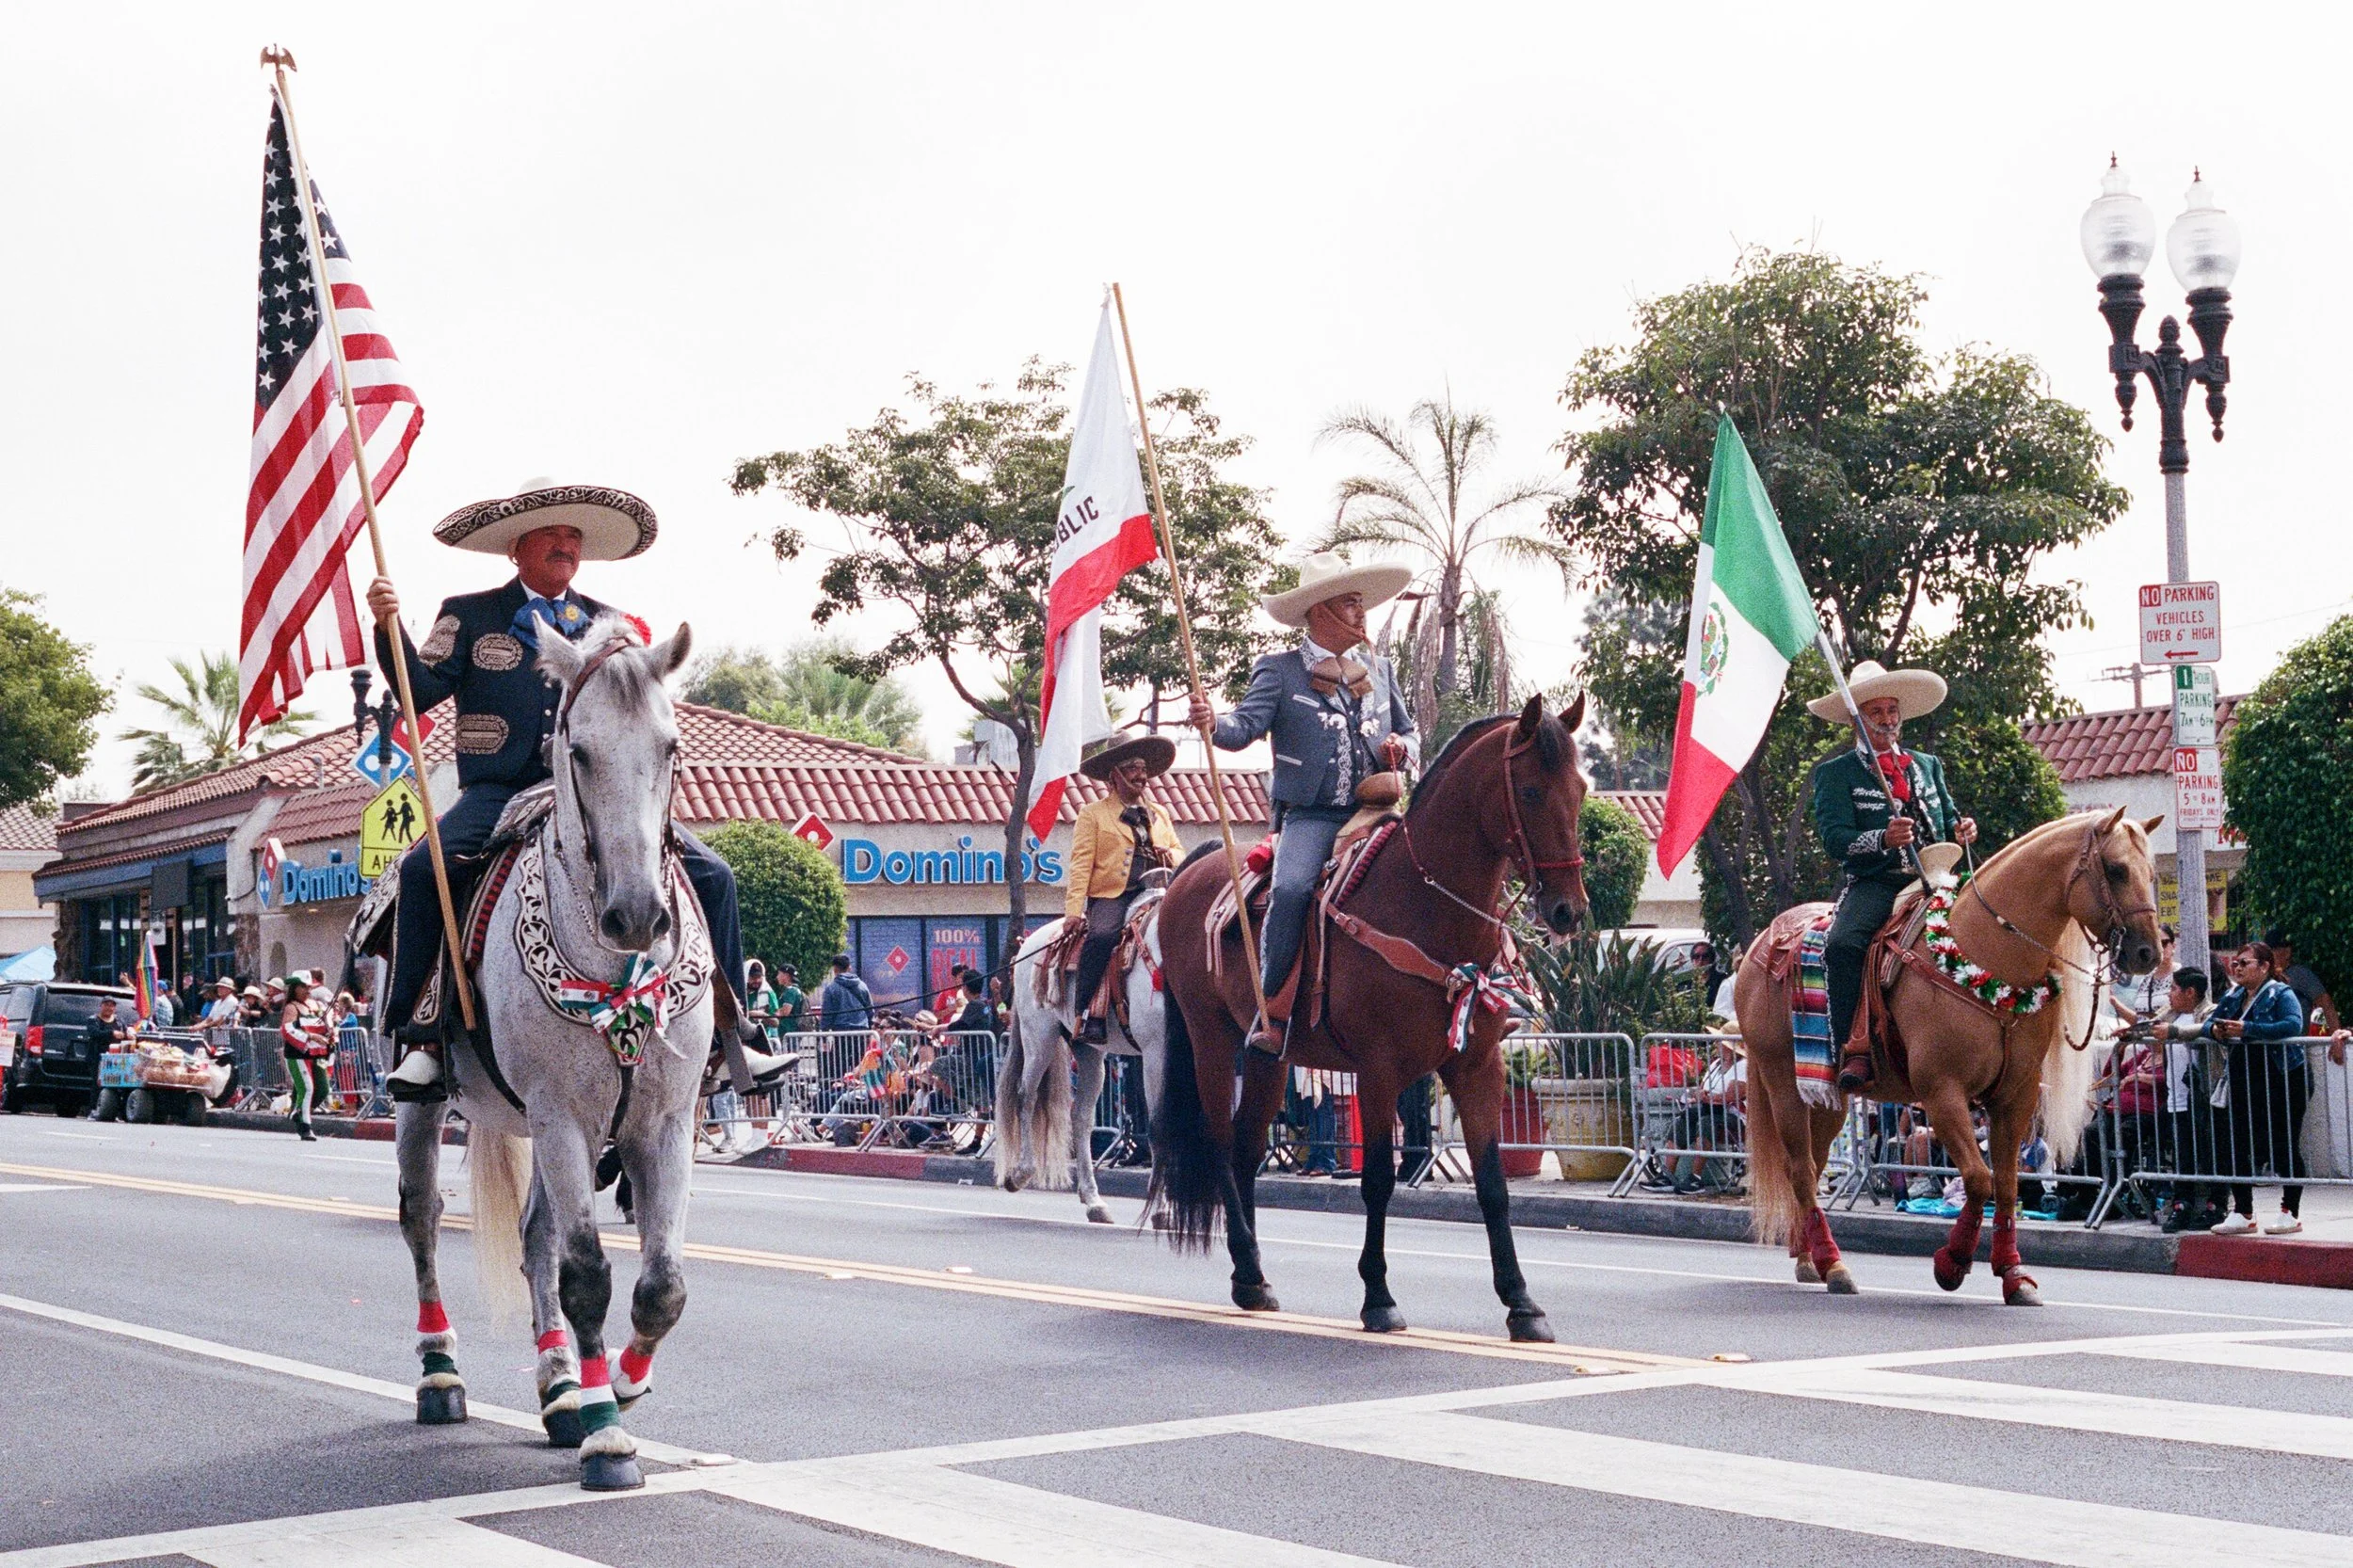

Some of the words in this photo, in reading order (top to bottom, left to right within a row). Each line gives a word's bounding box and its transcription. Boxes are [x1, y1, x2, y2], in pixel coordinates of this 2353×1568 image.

[1054, 496, 1099, 550] BLIC
[2141, 587, 2160, 605] NO
[2165, 585, 2214, 602] PARKING
[2156, 611, 2204, 625] VEHICLES
[2146, 630, 2171, 643] OVER
[2191, 627, 2215, 640] HIGH
[2180, 693, 2213, 708] PARKING
[2176, 752, 2196, 771] NO
[2179, 775, 2218, 790] PARKING
[2184, 792, 2190, 805] 5
[934, 928, 981, 943] 100%
